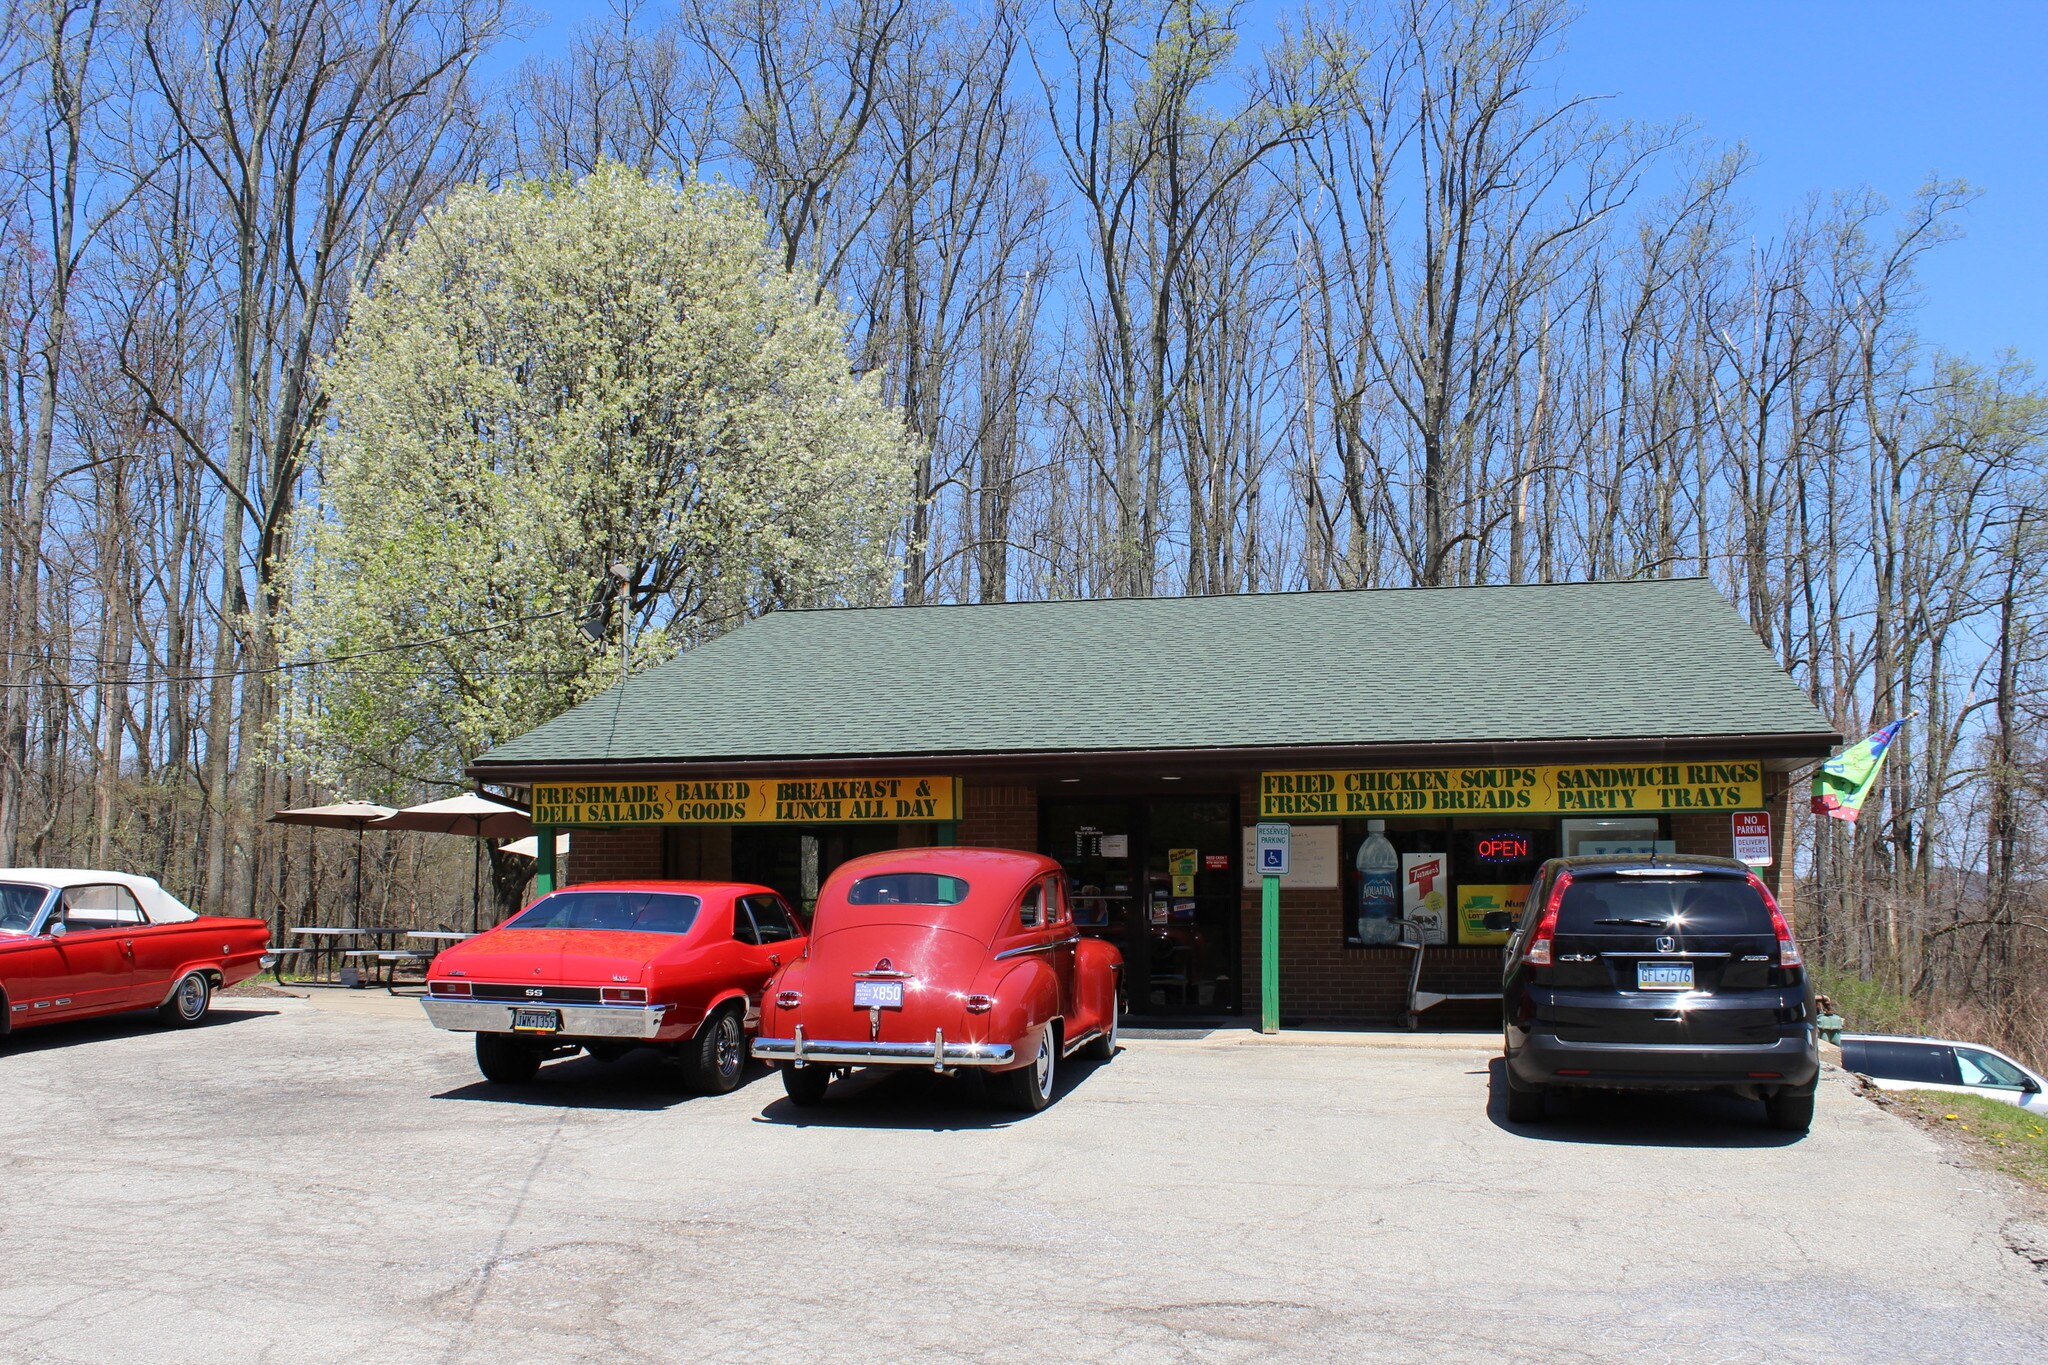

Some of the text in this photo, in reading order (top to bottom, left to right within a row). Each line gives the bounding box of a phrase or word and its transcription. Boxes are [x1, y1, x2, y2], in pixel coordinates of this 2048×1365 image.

[1264, 770, 1449, 794] FRIED CHICKEN
[1461, 768, 1536, 789] SOUPS
[1556, 763, 1759, 789] SANDWICH RINGS
[535, 785, 659, 804] FRESHMADE
[676, 782, 749, 800] BAKED
[777, 779, 931, 801] BREAKFAST &
[1557, 786, 1741, 809] PARTY TRAYS
[677, 802, 746, 820] GOODS
[775, 798, 938, 820] LUNCH ALL DAY
[1264, 789, 1531, 814] FRESH BAKED BREADS
[535, 803, 664, 822] DELI SALADS
[1744, 815, 1758, 825] NO
[1737, 825, 1766, 834] PARKING
[1478, 840, 1527, 856] OPEN
[1362, 884, 1395, 900] AQUAFINA
[525, 988, 543, 997] SS
[872, 986, 901, 1001] X850
